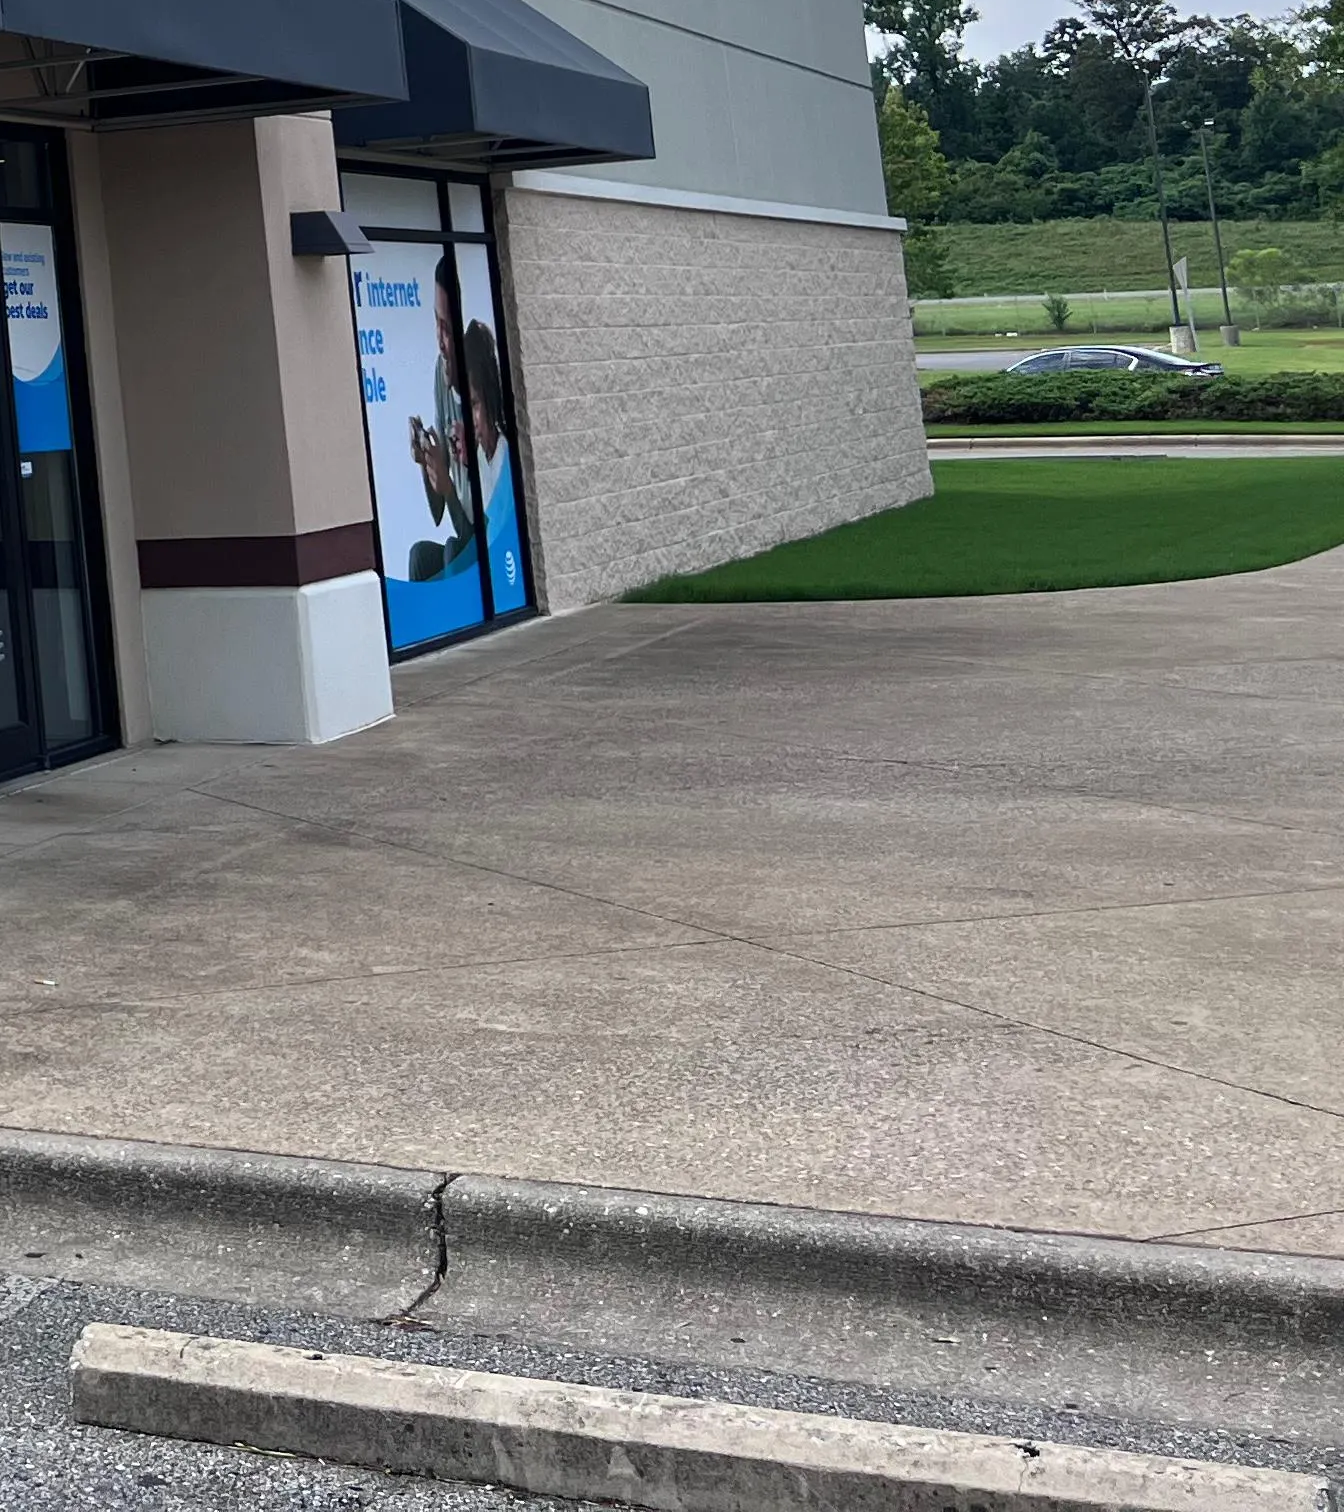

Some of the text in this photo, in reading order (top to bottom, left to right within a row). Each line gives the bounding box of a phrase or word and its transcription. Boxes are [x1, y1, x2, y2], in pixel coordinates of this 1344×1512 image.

[19, 282, 34, 295] our
[366, 272, 421, 307] internet
[26, 301, 48, 319] deals
